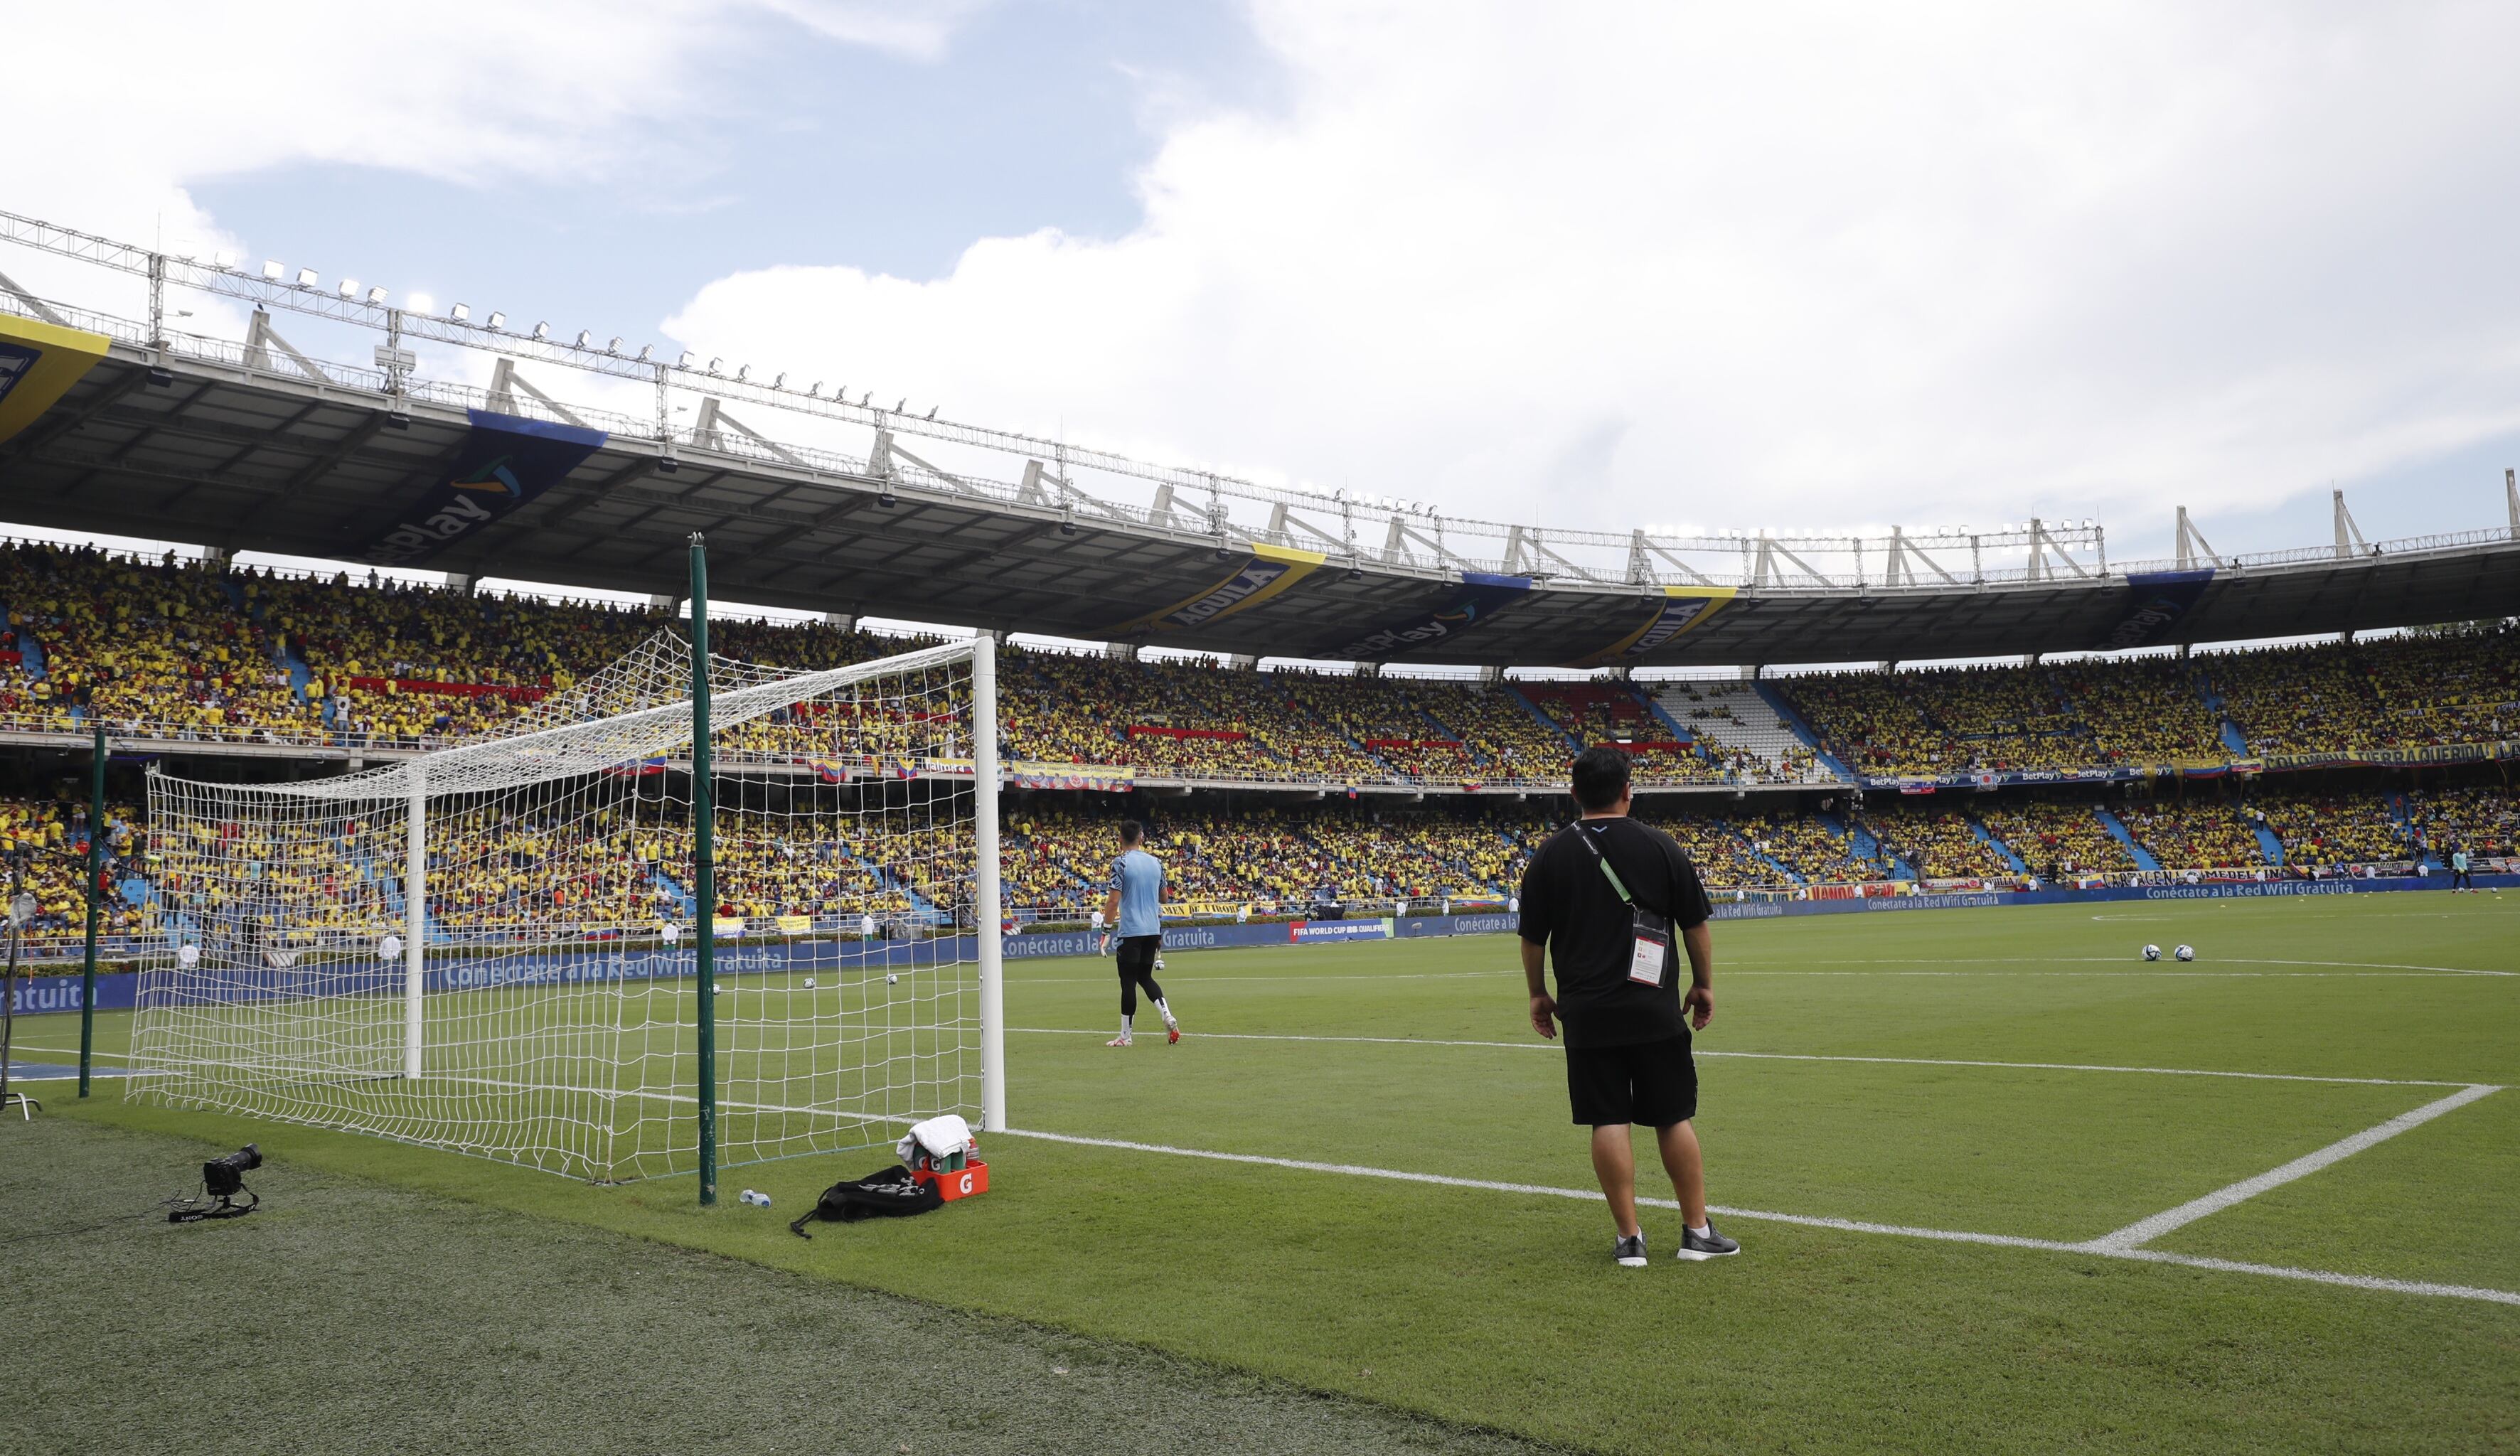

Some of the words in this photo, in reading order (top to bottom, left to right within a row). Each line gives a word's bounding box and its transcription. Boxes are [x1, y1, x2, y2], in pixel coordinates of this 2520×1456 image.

[1171, 569, 1286, 626] AGUILA
[2265, 751, 2348, 771] COLOMBIA
[2355, 749, 2417, 766] TIERRA
[2419, 744, 2484, 764] QUERIDA
[2023, 771, 2054, 781] BetPlay
[2130, 766, 2162, 776] BetPlay
[1870, 777, 1899, 786] BetPlay
[2205, 869, 2280, 879] MEDELIN
[2147, 887, 2209, 899] Conéctate
[2222, 884, 2233, 896] la
[2236, 884, 2261, 896] Red
[2264, 882, 2293, 895] Wifi
[2296, 881, 2354, 894] Gratuita
[1721, 906, 1727, 917] la
[1729, 904, 1741, 917] Red
[1742, 904, 1756, 916] Wifi
[1756, 903, 1782, 916] Gratuita
[1868, 897, 1906, 910] Conéctate
[1915, 896, 1922, 908] la
[1924, 895, 1940, 907] Red
[1942, 894, 1960, 906] Wifi
[1961, 894, 1999, 906] Gratuita
[1309, 926, 1333, 936] WORLD
[1359, 924, 1389, 933] QUALIFIERS
[1455, 917, 1500, 931] Conéctate
[1502, 919, 1507, 929] a
[1508, 914, 1517, 929] la
[1001, 936, 1075, 956] Conéctate
[1076, 942, 1084, 952] a
[1087, 933, 1099, 951] la
[1163, 928, 1215, 947] Gratuita
[445, 961, 559, 985] Conéctate
[566, 965, 577, 979] a
[584, 956, 602, 978] la
[609, 953, 648, 978] Red
[653, 951, 698, 975] Wifi
[712, 948, 781, 971] ratuita
[931, 1157, 941, 1171] G
[960, 1173, 973, 1194] G
